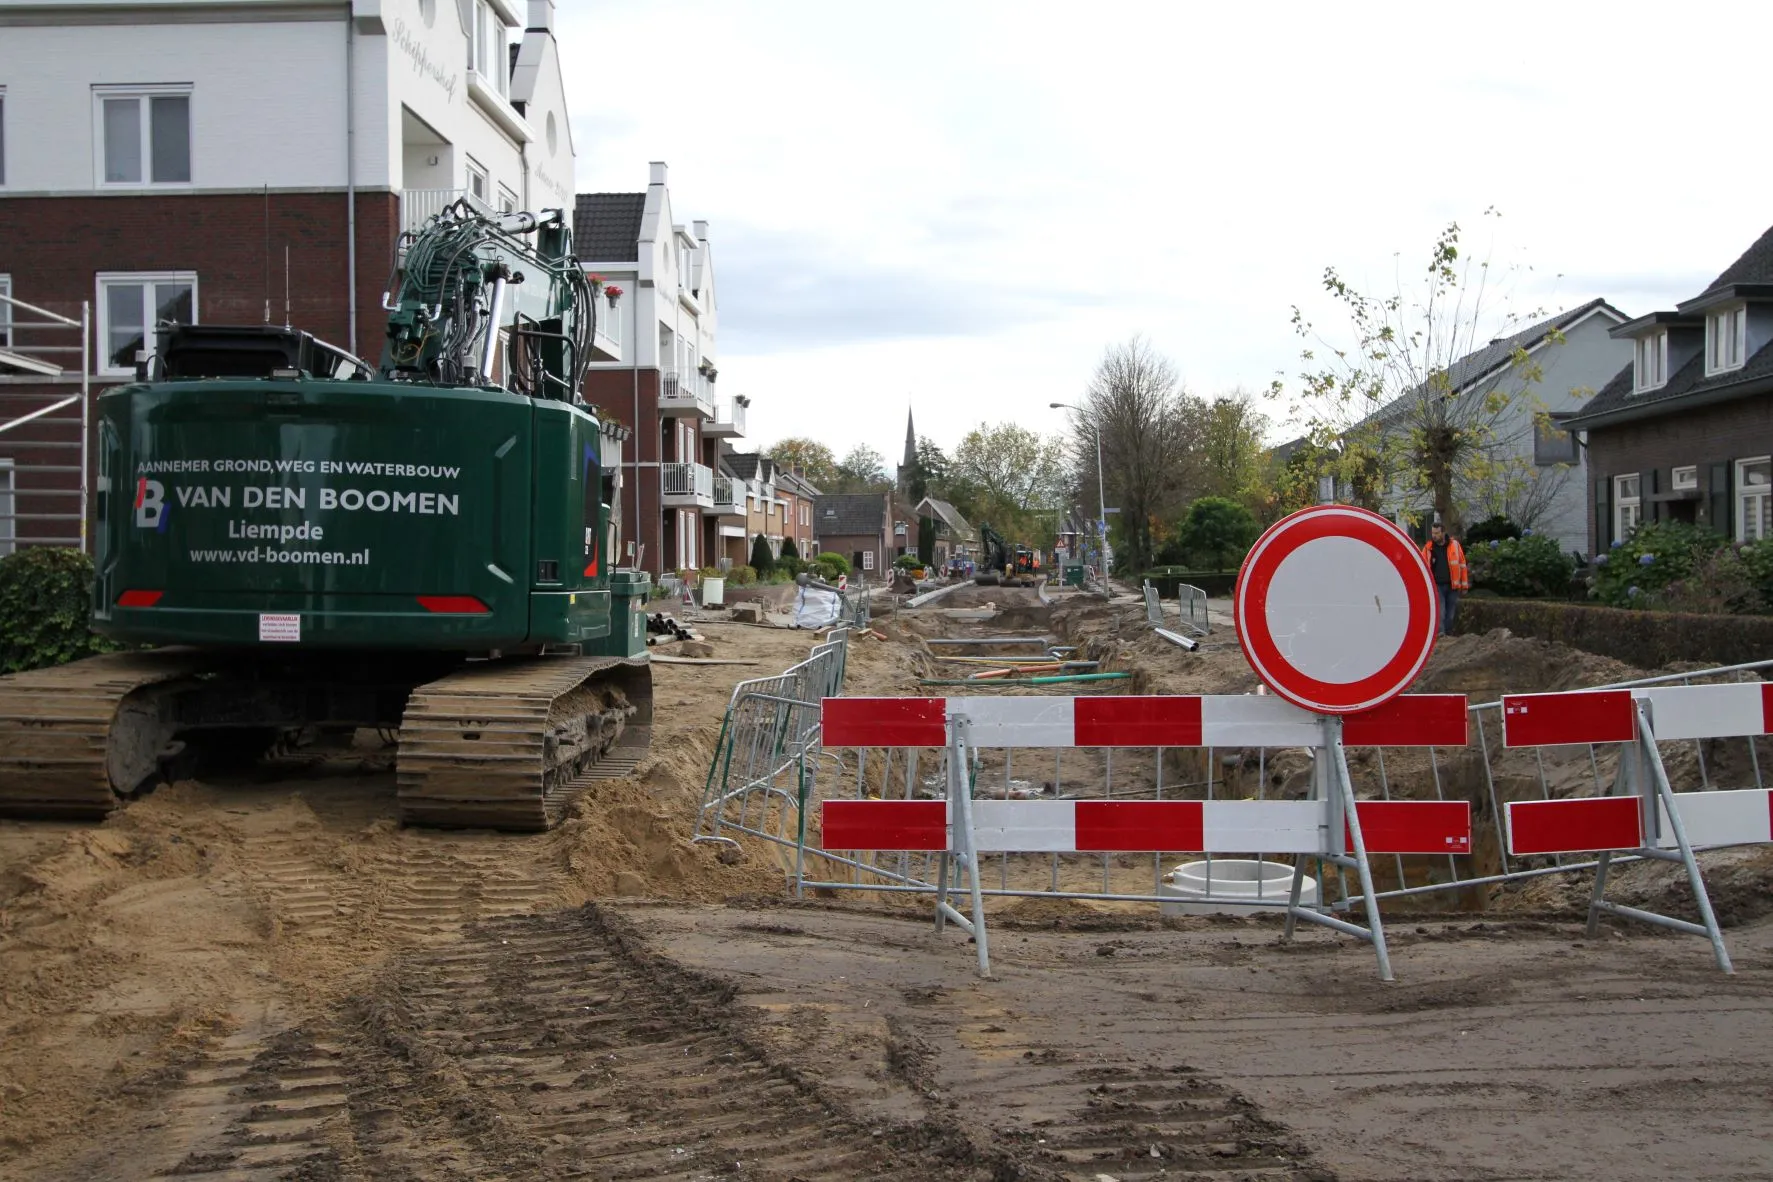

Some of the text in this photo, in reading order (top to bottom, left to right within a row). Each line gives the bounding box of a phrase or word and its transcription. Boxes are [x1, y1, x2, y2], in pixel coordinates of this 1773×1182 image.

[392, 17, 457, 104] Schippershof
[137, 460, 210, 474] AANNEMER
[320, 461, 343, 473] EN
[346, 461, 461, 480] WATERBOUW
[175, 487, 459, 515] VAN DEN BOOMEN
[229, 520, 324, 544] Liempde
[190, 547, 370, 566] www.vd-boomen.nl
